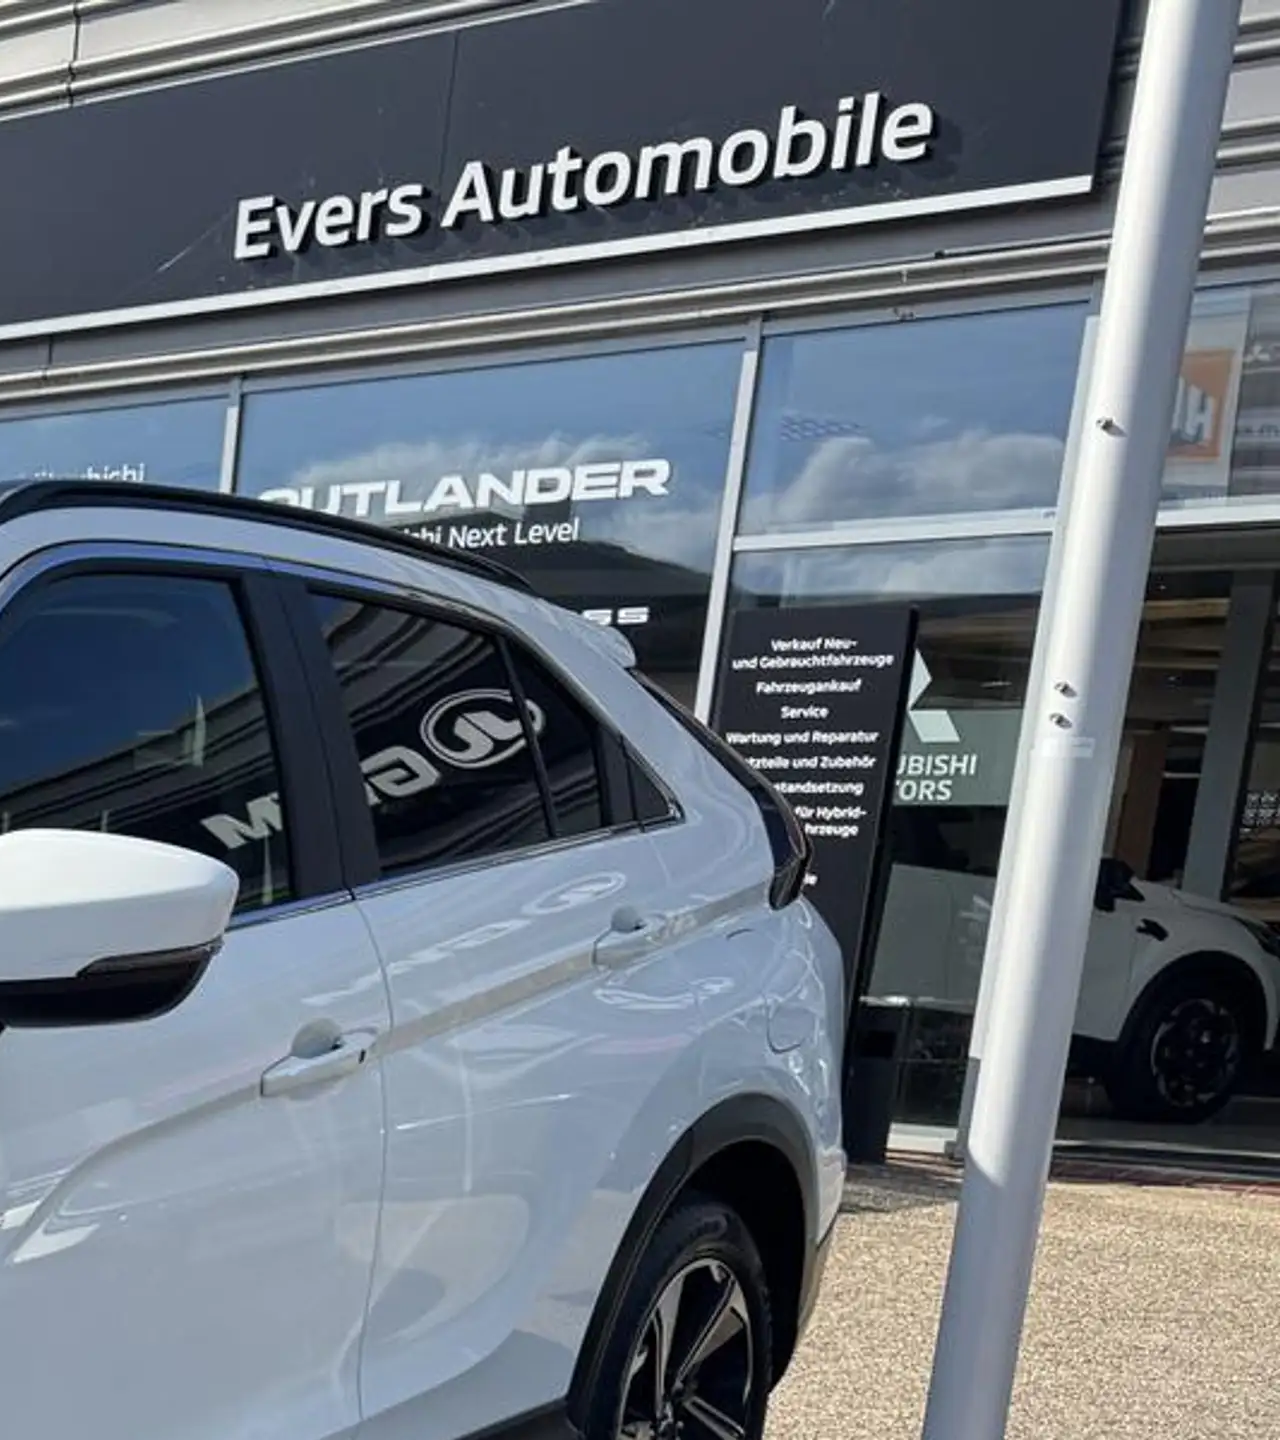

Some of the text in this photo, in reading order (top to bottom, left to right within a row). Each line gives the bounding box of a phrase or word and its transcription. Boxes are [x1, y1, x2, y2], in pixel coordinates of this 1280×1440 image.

[233, 90, 934, 260] Evers Automobile
[448, 524, 507, 549] Next
[515, 518, 579, 546] Level
[771, 637, 858, 651] Verkauf Neu-
[732, 654, 894, 669] und Gebrauchtfahrzeuge
[756, 679, 863, 695] Fahrzeugankauf
[780, 706, 829, 719] Service
[726, 731, 880, 746] Wartung und Reparatur
[792, 756, 818, 769] und
[820, 755, 877, 769] Zubehör
[896, 780, 953, 801] ORS
[816, 805, 868, 821] Hybrid-
